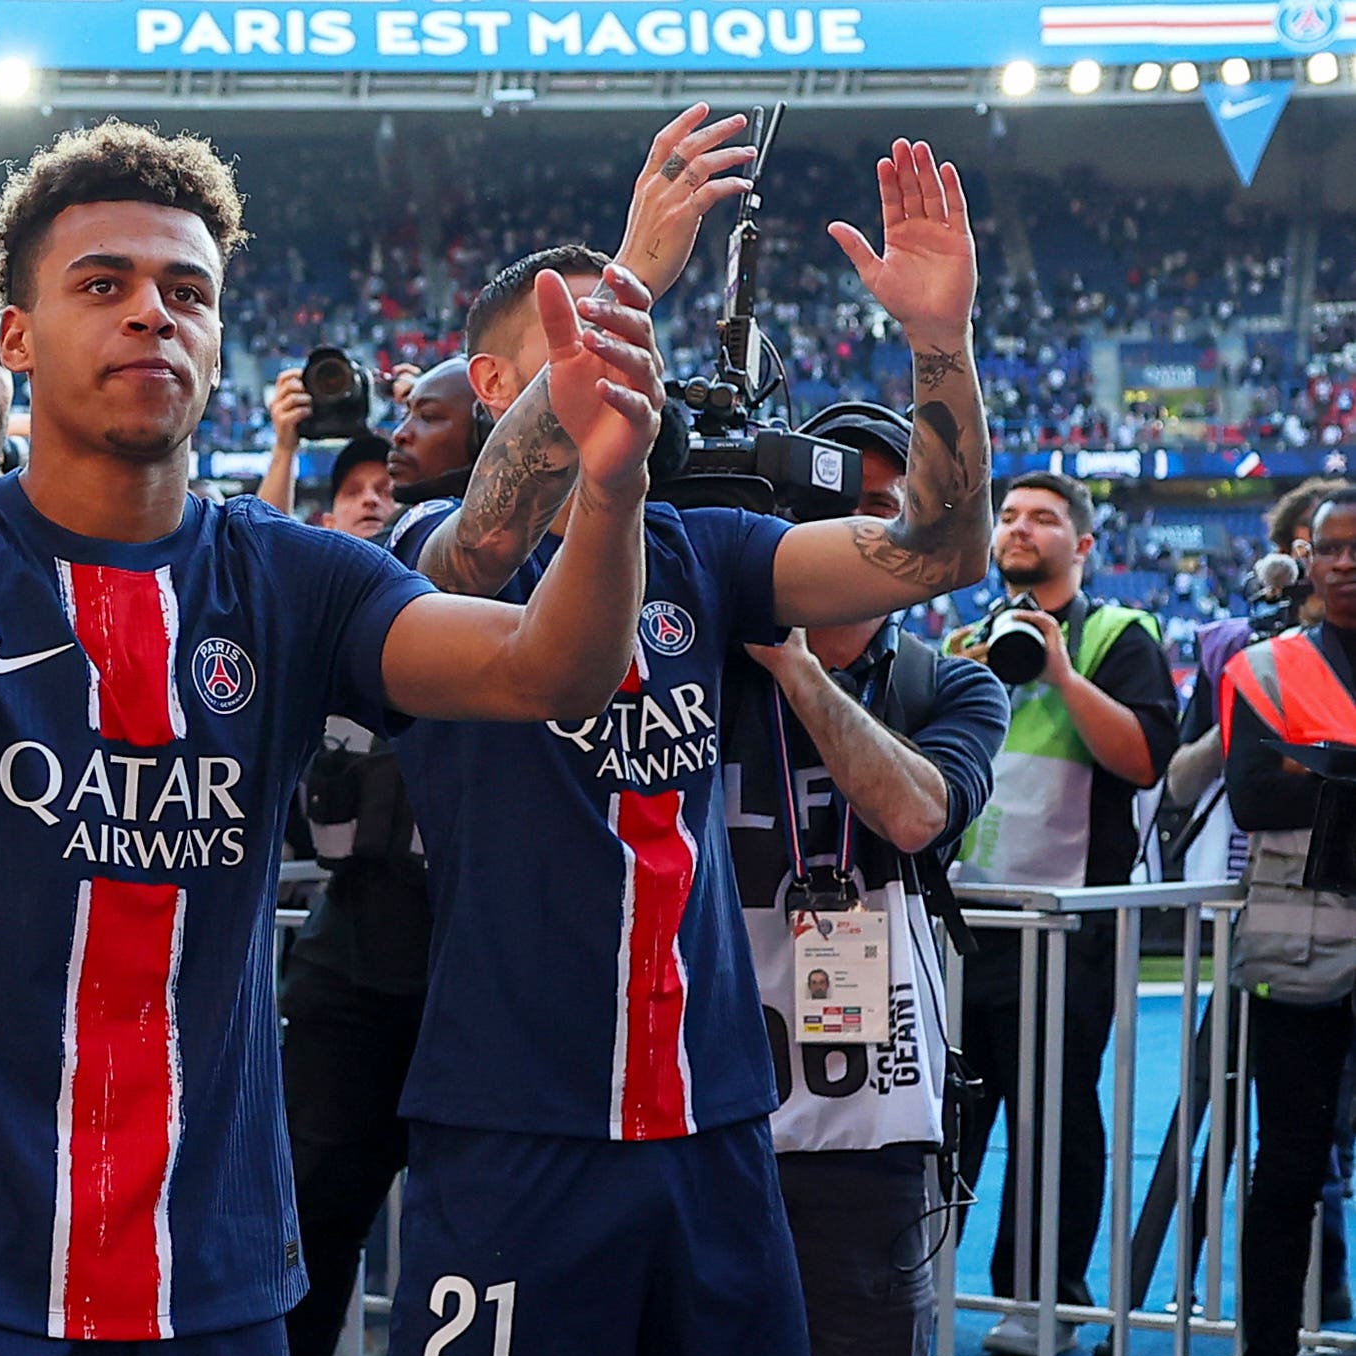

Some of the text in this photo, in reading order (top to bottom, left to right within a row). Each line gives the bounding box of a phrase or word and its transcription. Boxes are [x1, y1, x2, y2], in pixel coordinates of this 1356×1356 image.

[137, 9, 866, 58] PARIS EST MAGIQUE
[642, 604, 676, 620] PARIS
[200, 642, 240, 661] PARIS
[0, 740, 246, 826] QATAR
[62, 820, 245, 870] AIRWAYS
